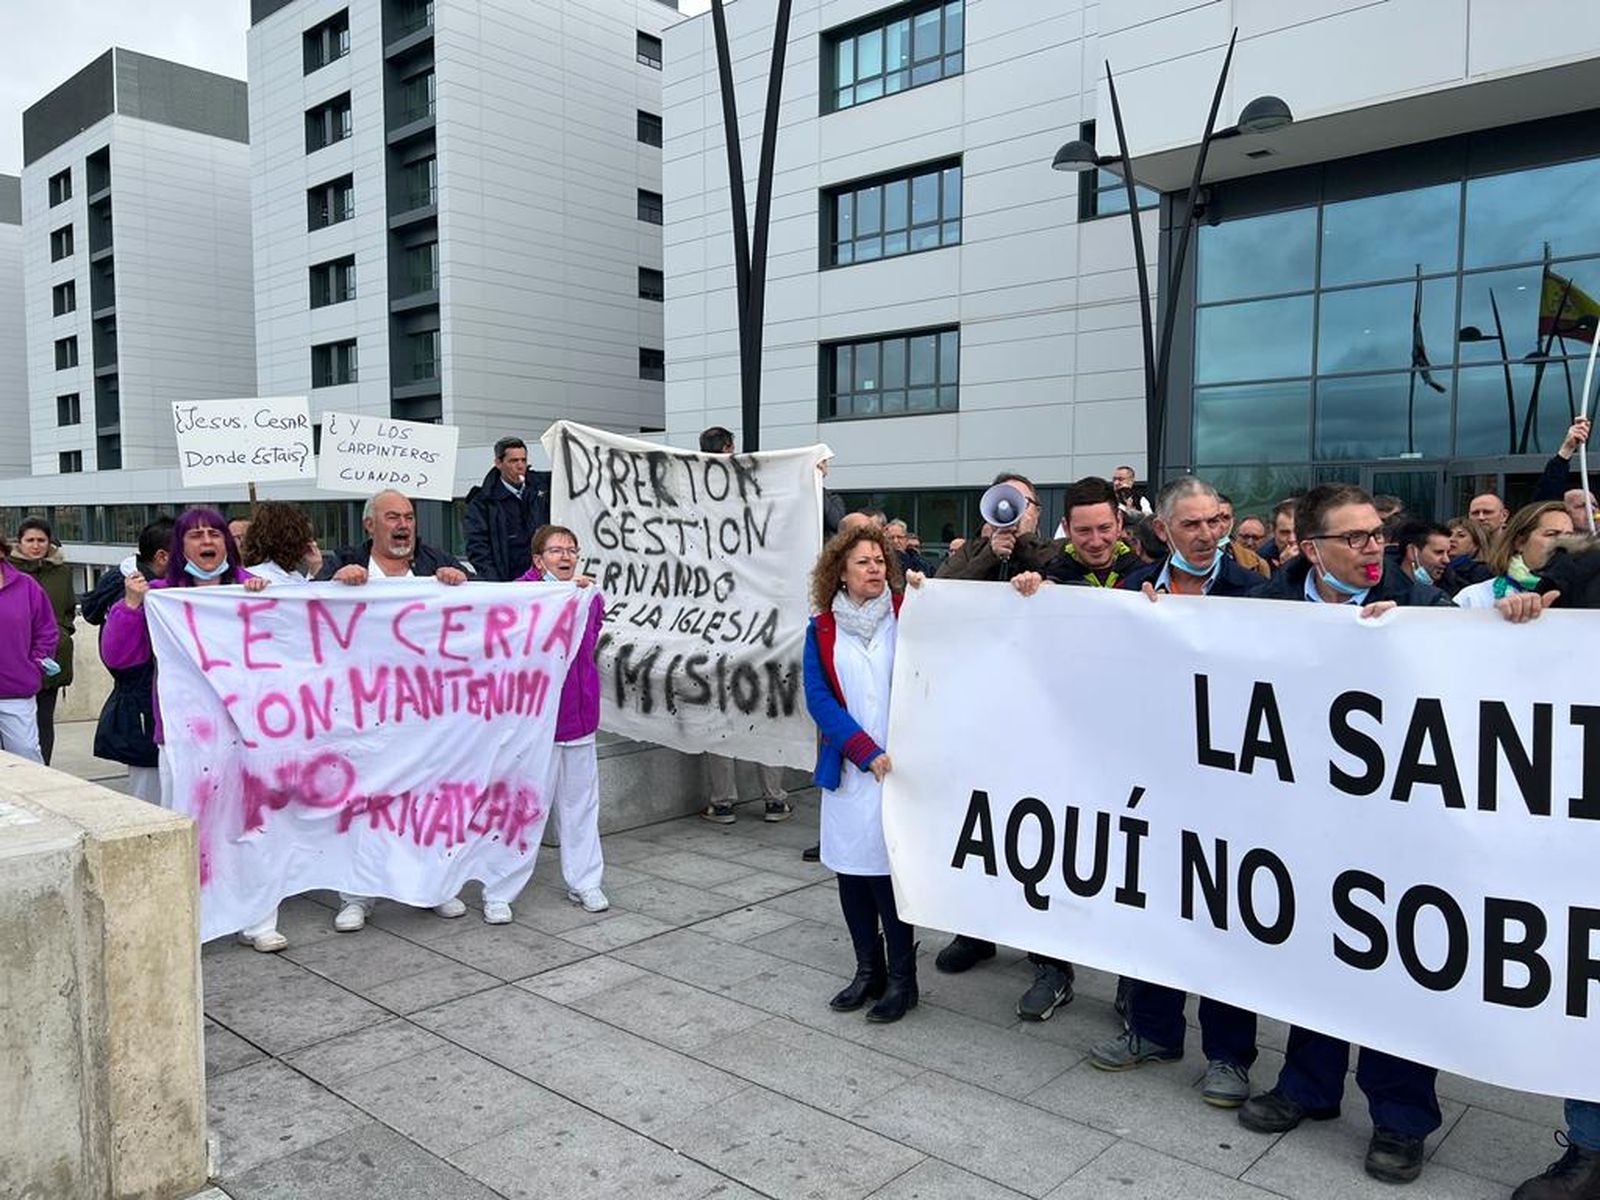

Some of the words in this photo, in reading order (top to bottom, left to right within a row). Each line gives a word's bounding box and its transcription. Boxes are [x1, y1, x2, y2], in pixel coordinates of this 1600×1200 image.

[337, 440, 440, 463] CARPINTEROS
[377, 423, 413, 440] LOS
[184, 450, 247, 468] Donde
[594, 503, 775, 561] GESTION
[577, 555, 735, 604] ERNANDO
[600, 602, 628, 623] E
[629, 604, 662, 630] LA
[669, 607, 779, 648] IGLESIA
[1195, 674, 1296, 784] LA
[952, 786, 1149, 911] AQUÍ
[1181, 830, 1296, 946] NO
